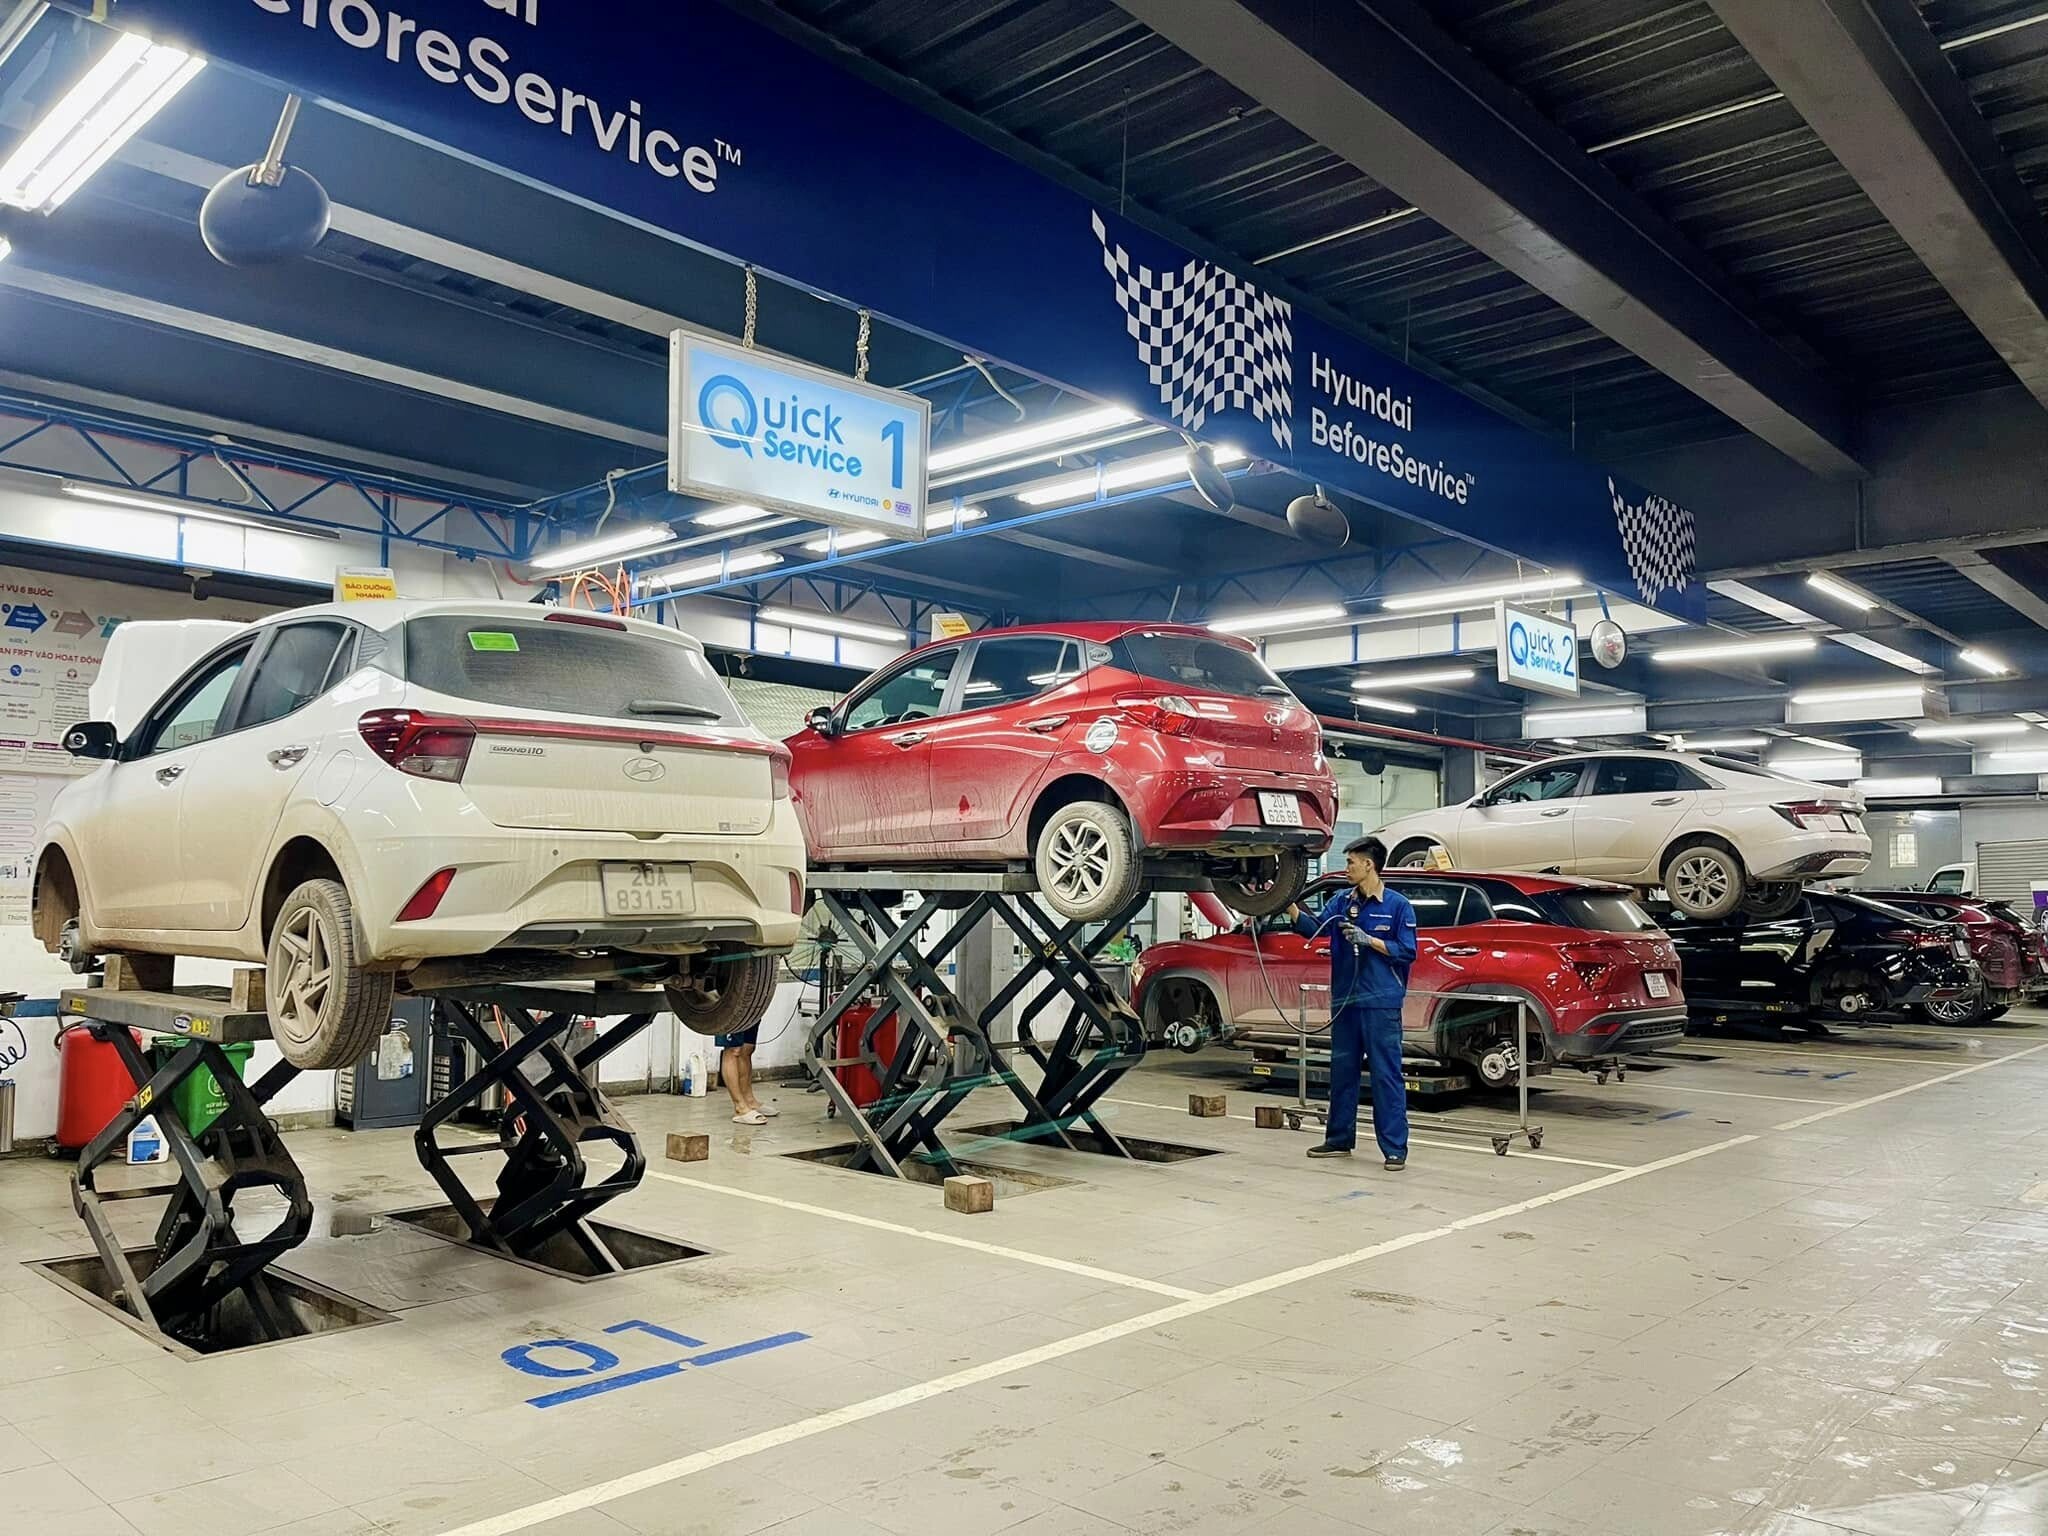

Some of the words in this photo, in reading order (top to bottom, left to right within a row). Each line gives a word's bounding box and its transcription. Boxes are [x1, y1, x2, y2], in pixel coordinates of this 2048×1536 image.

[1311, 351, 1412, 432] Hyundai
[698, 374, 845, 460] Quick
[763, 430, 863, 477] Service
[881, 419, 905, 490] 1
[1509, 621, 1556, 670] Quick
[1530, 650, 1562, 674] Service
[1562, 634, 1575, 678] 2
[616, 889, 685, 911] 831.51
[630, 866, 668, 887] 20A
[501, 1319, 707, 1378] 01
